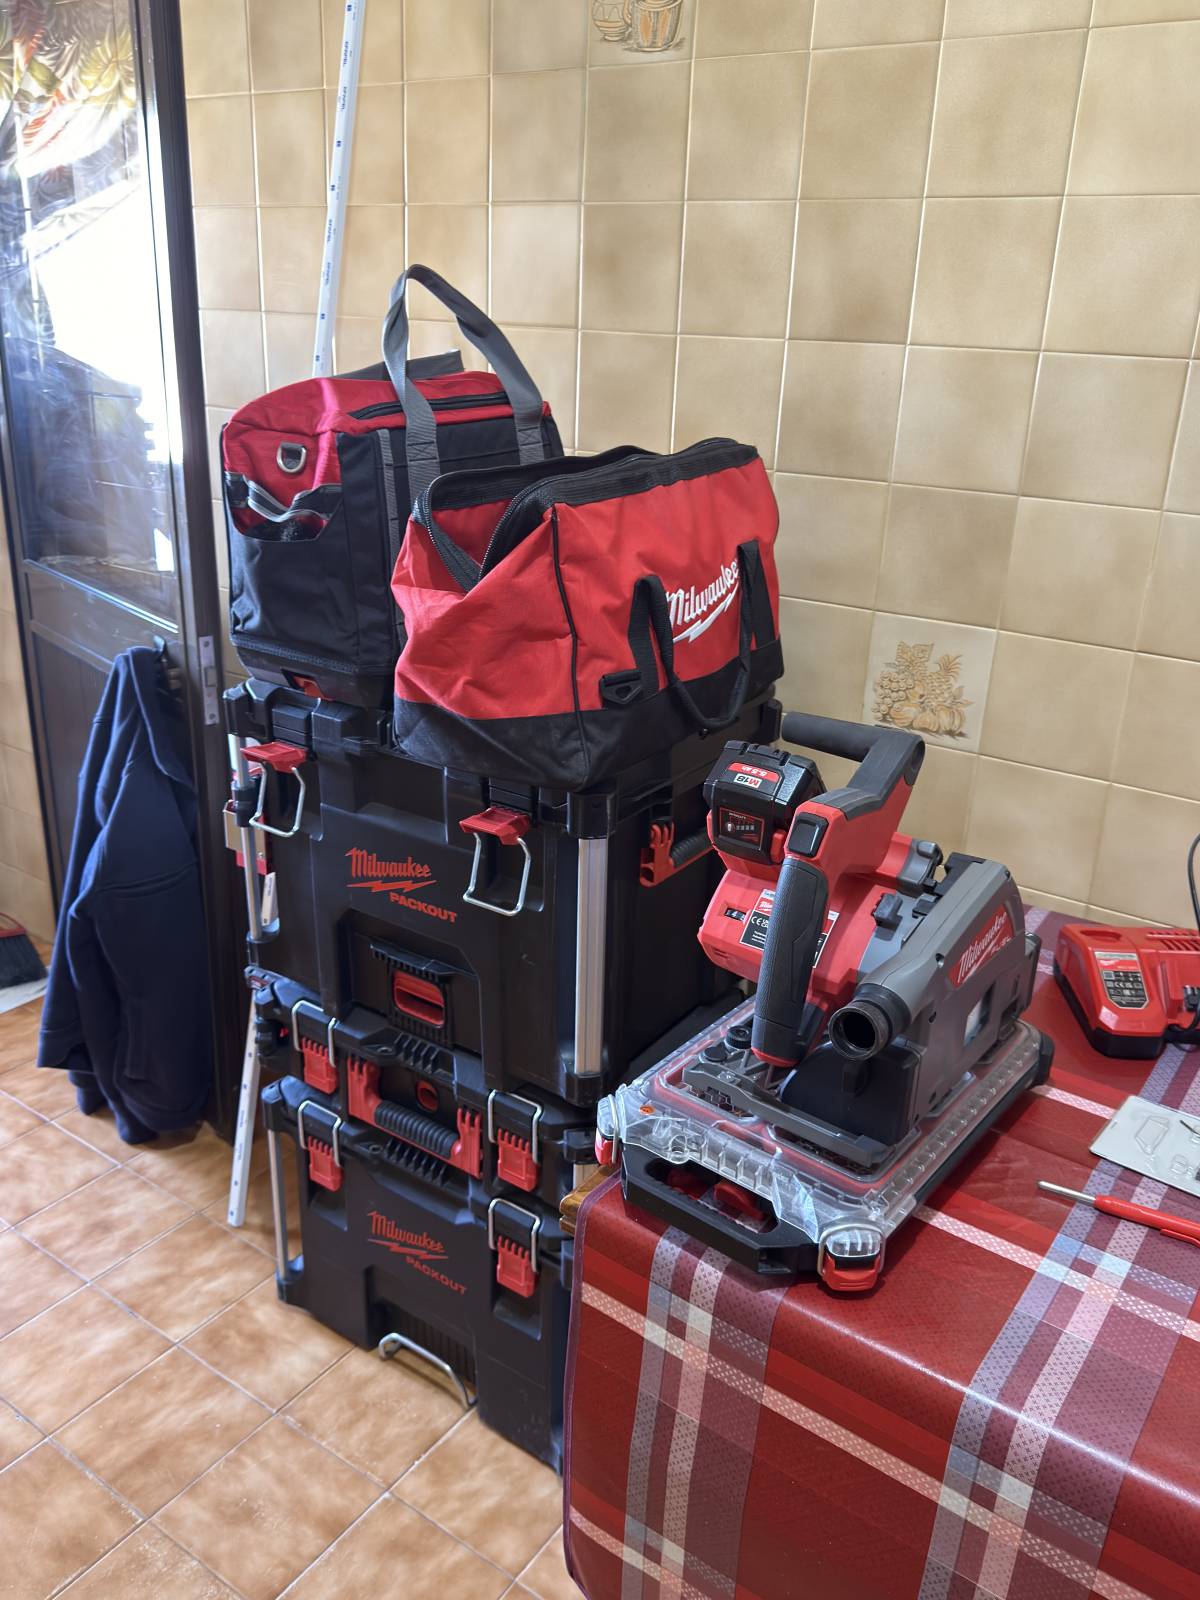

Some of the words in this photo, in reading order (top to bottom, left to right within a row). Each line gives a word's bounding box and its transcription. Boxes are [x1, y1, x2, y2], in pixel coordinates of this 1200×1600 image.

[666, 559, 739, 628] Milwaukee
[736, 775, 759, 786] M18
[344, 847, 432, 879] Milwaukee
[388, 891, 458, 923] PACKOUT
[957, 911, 1007, 983] Milwaukee
[367, 1210, 445, 1253] Milwaukee
[405, 1255, 467, 1296] PACKOUT
